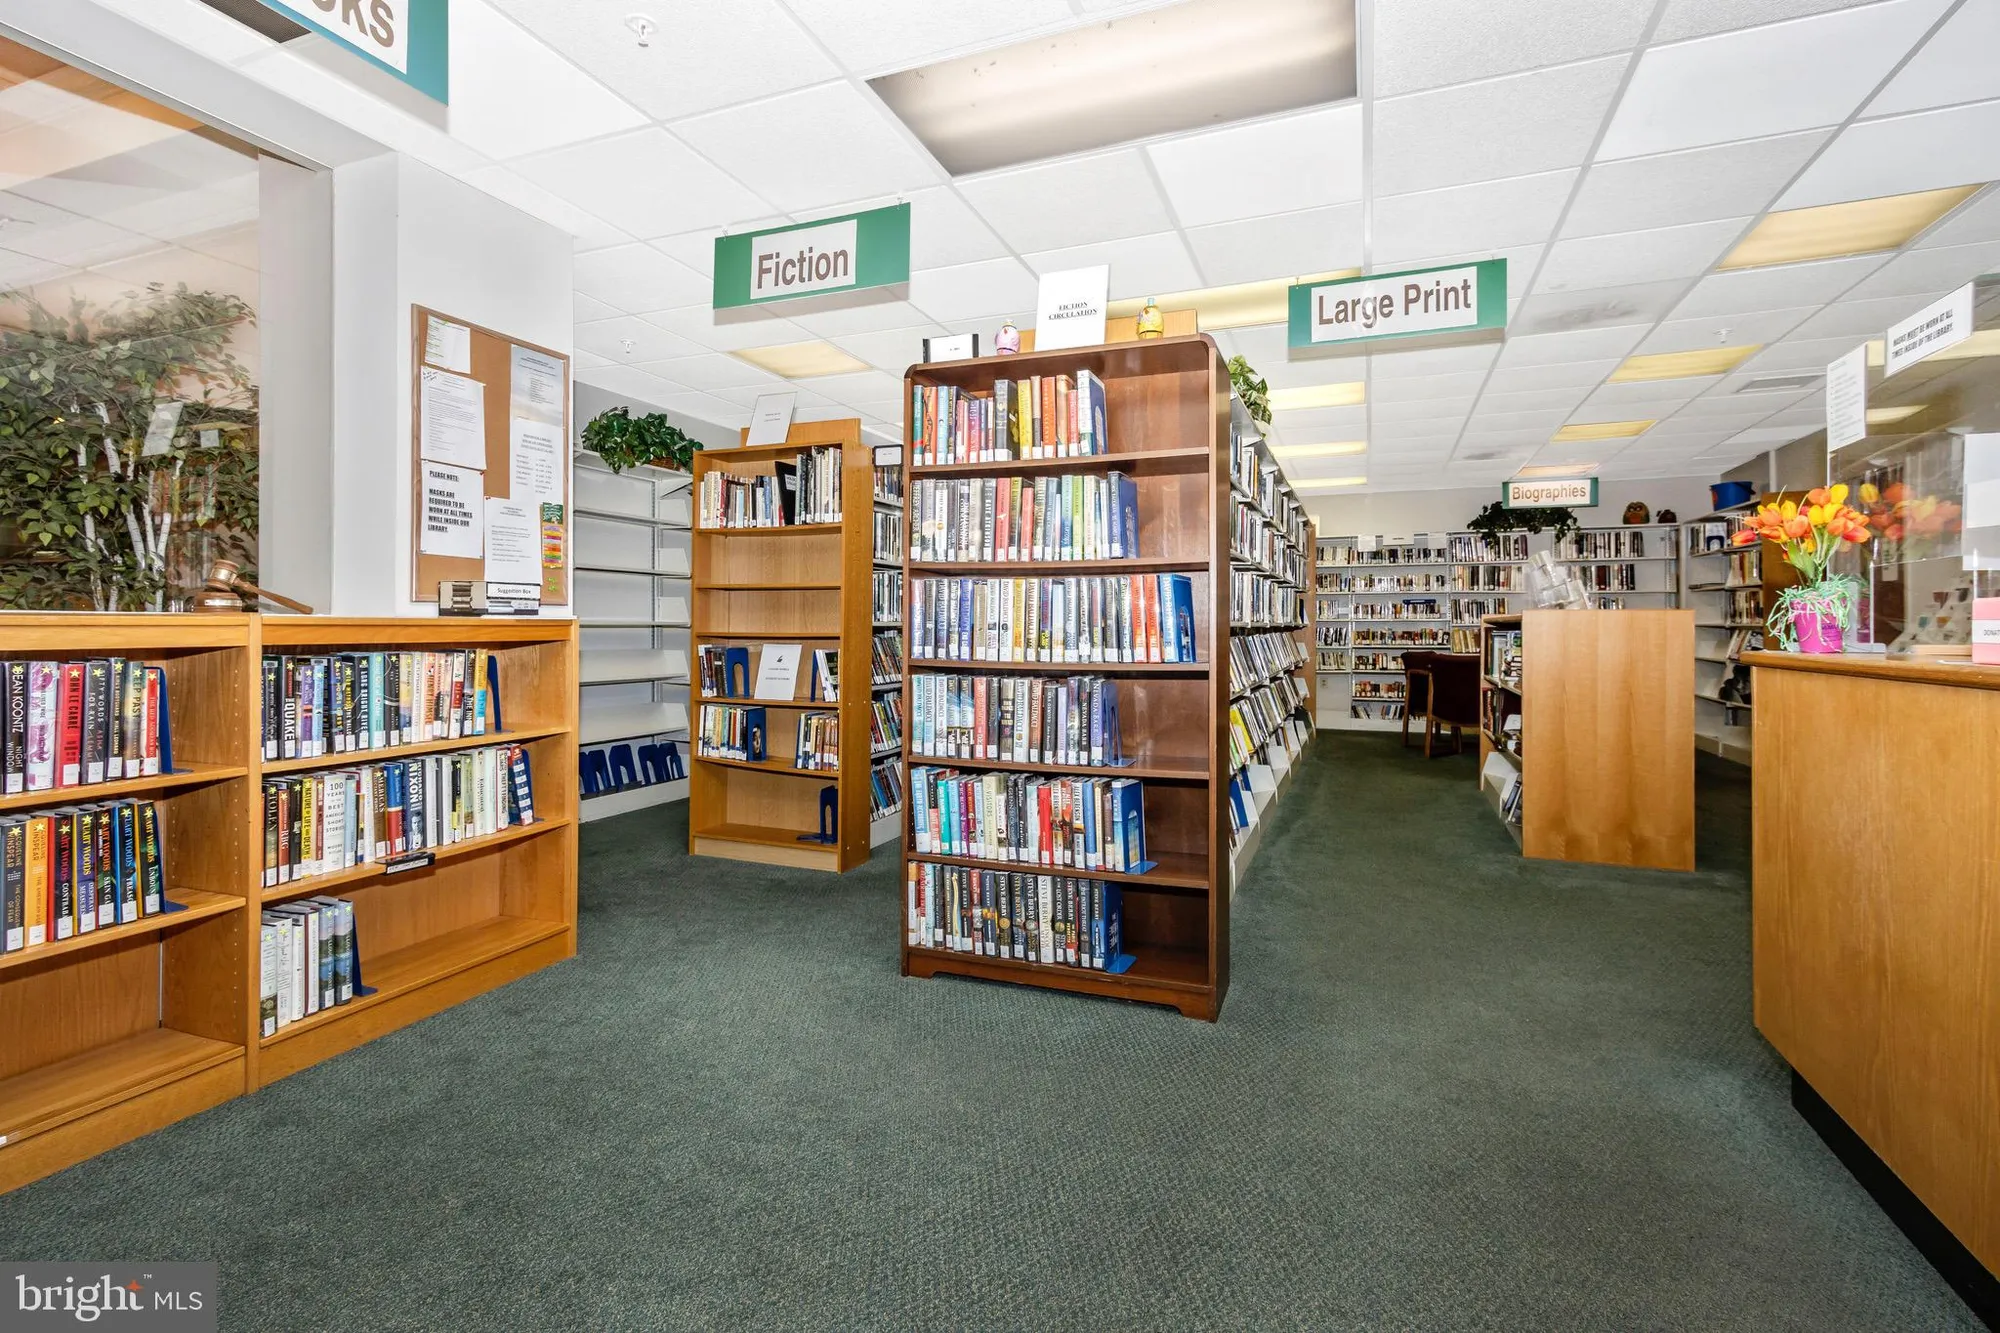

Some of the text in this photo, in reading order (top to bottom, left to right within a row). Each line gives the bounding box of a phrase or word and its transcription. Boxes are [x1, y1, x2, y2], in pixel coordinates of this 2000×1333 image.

[311, 0, 395, 48] KS
[757, 246, 849, 289] Fiction
[1048, 308, 1098, 321] CIRCULATION
[1058, 301, 1089, 311] FICTION
[1318, 279, 1472, 329] Large Print
[1907, 326, 1919, 341] MUST
[429, 470, 446, 480] PLEASE
[429, 488, 446, 497] MASKS
[429, 497, 452, 507] REQUIRED
[1512, 485, 1586, 502] Biographies
[428, 515, 470, 527] WHILE INSIDE OUR
[458, 510, 473, 519] TIMES
[497, 587, 522, 595] Suggestion
[1027, 582, 1036, 602] DAVID
[1163, 577, 1173, 600] DAVID
[68, 676, 80, 693] OHN
[133, 677, 142, 693] EEP
[360, 671, 369, 713] LONG BRIGHT
[426, 675, 435, 697] HENRY
[69, 695, 79, 703] LE
[88, 693, 96, 708] FOR
[132, 697, 141, 719] PAST
[466, 697, 474, 710] THE
[1092, 683, 1100, 712] NEVADA
[12, 696, 24, 733] KOONTZ
[67, 706, 82, 730] CARRÉ
[97, 695, 105, 723] WORDS
[925, 696, 933, 723] BALDACCI
[1030, 700, 1038, 728] BALDACCI
[284, 703, 296, 740] QUAKE
[14, 746, 23, 767] NIGHT
[330, 782, 344, 791] 100
[409, 763, 420, 803] NIXON
[268, 793, 278, 831] TOLEN
[328, 803, 344, 811] BEST
[985, 790, 993, 818] VISITORS
[1052, 795, 1060, 818] BERENSON
[146, 835, 155, 863] WOODS
[280, 830, 289, 850] RBG
[303, 836, 311, 855] DEATH
[83, 847, 92, 876] WOODS
[124, 839, 134, 867] WOODS
[61, 851, 70, 880] WOODS
[103, 843, 111, 893] WOODS SKIN
[1027, 898, 1035, 920] BERRY
